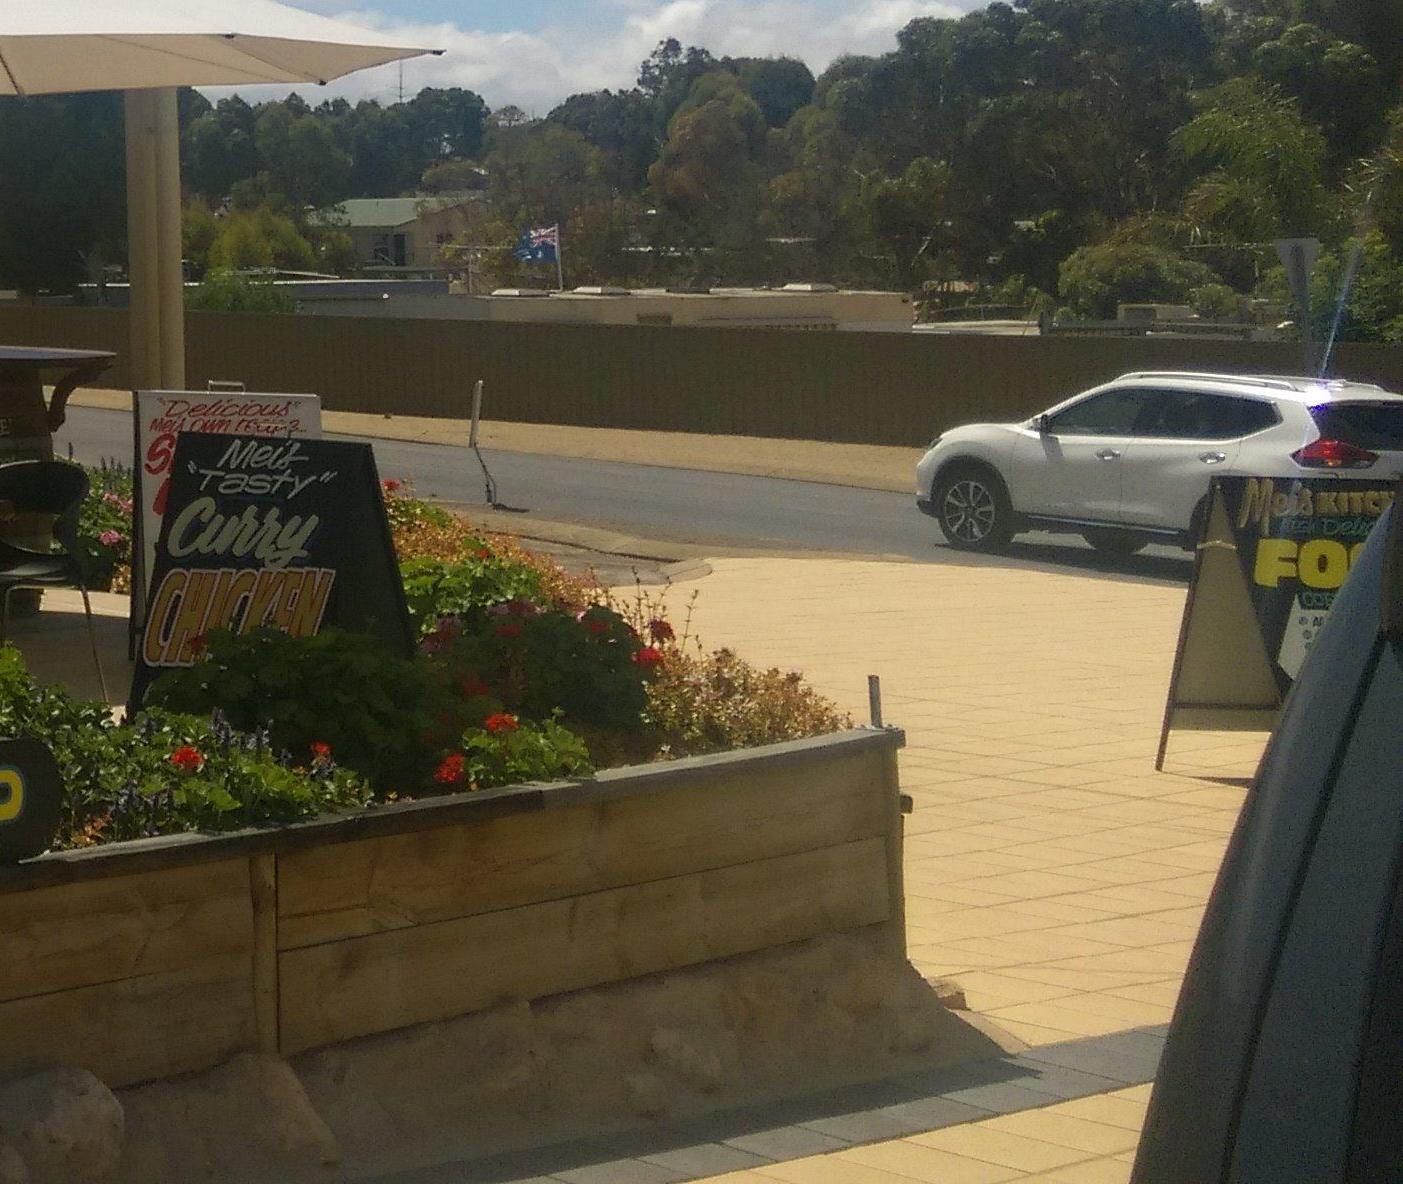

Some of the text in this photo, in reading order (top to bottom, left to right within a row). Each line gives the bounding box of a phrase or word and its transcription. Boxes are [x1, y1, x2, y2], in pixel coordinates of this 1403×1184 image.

[167, 496, 321, 568] Curry
[1254, 538, 1363, 589] FO
[143, 567, 336, 667] CHICKEN
